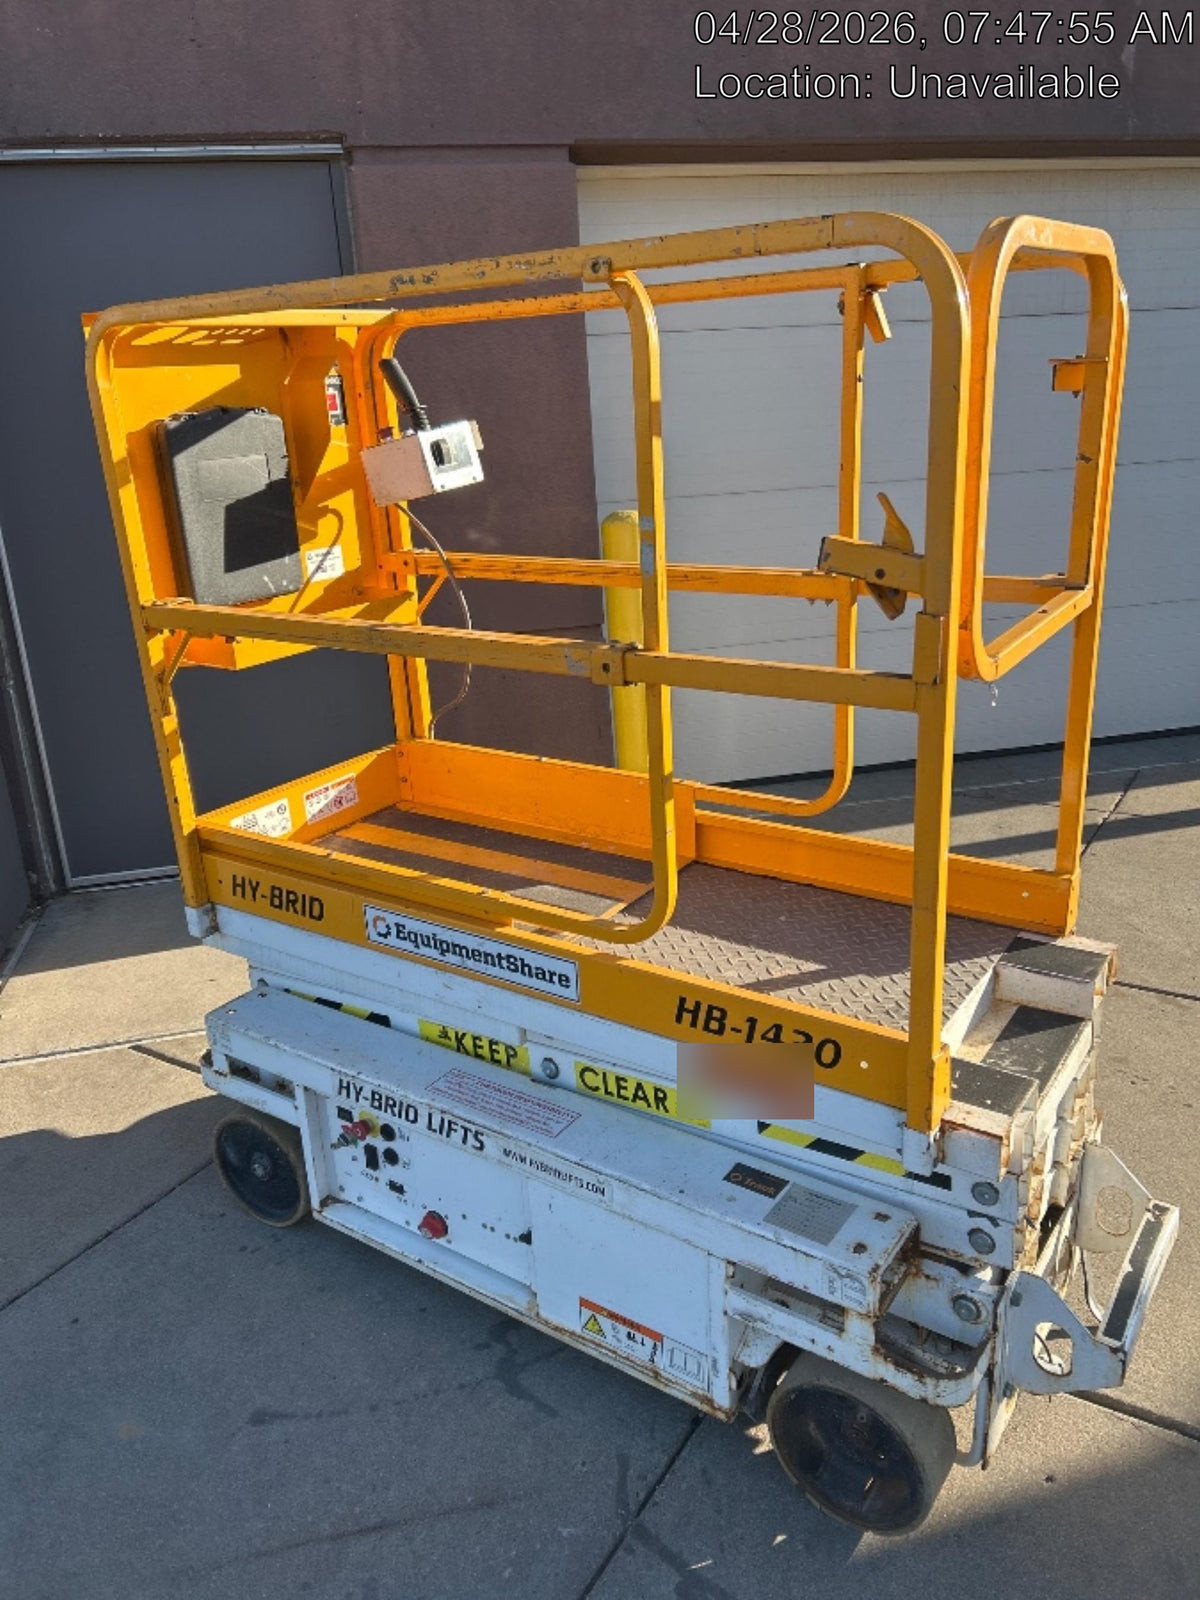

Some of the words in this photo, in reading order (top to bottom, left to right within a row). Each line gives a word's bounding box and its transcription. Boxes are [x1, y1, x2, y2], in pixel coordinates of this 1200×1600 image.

[232, 874, 325, 923] HY-BRID
[394, 921, 572, 989] EquipmentShare
[454, 1029, 518, 1068] KEEP
[579, 1066, 670, 1114] CLEAR
[338, 1078, 419, 1125] HY-BRID
[426, 1111, 485, 1151] LIFTS
